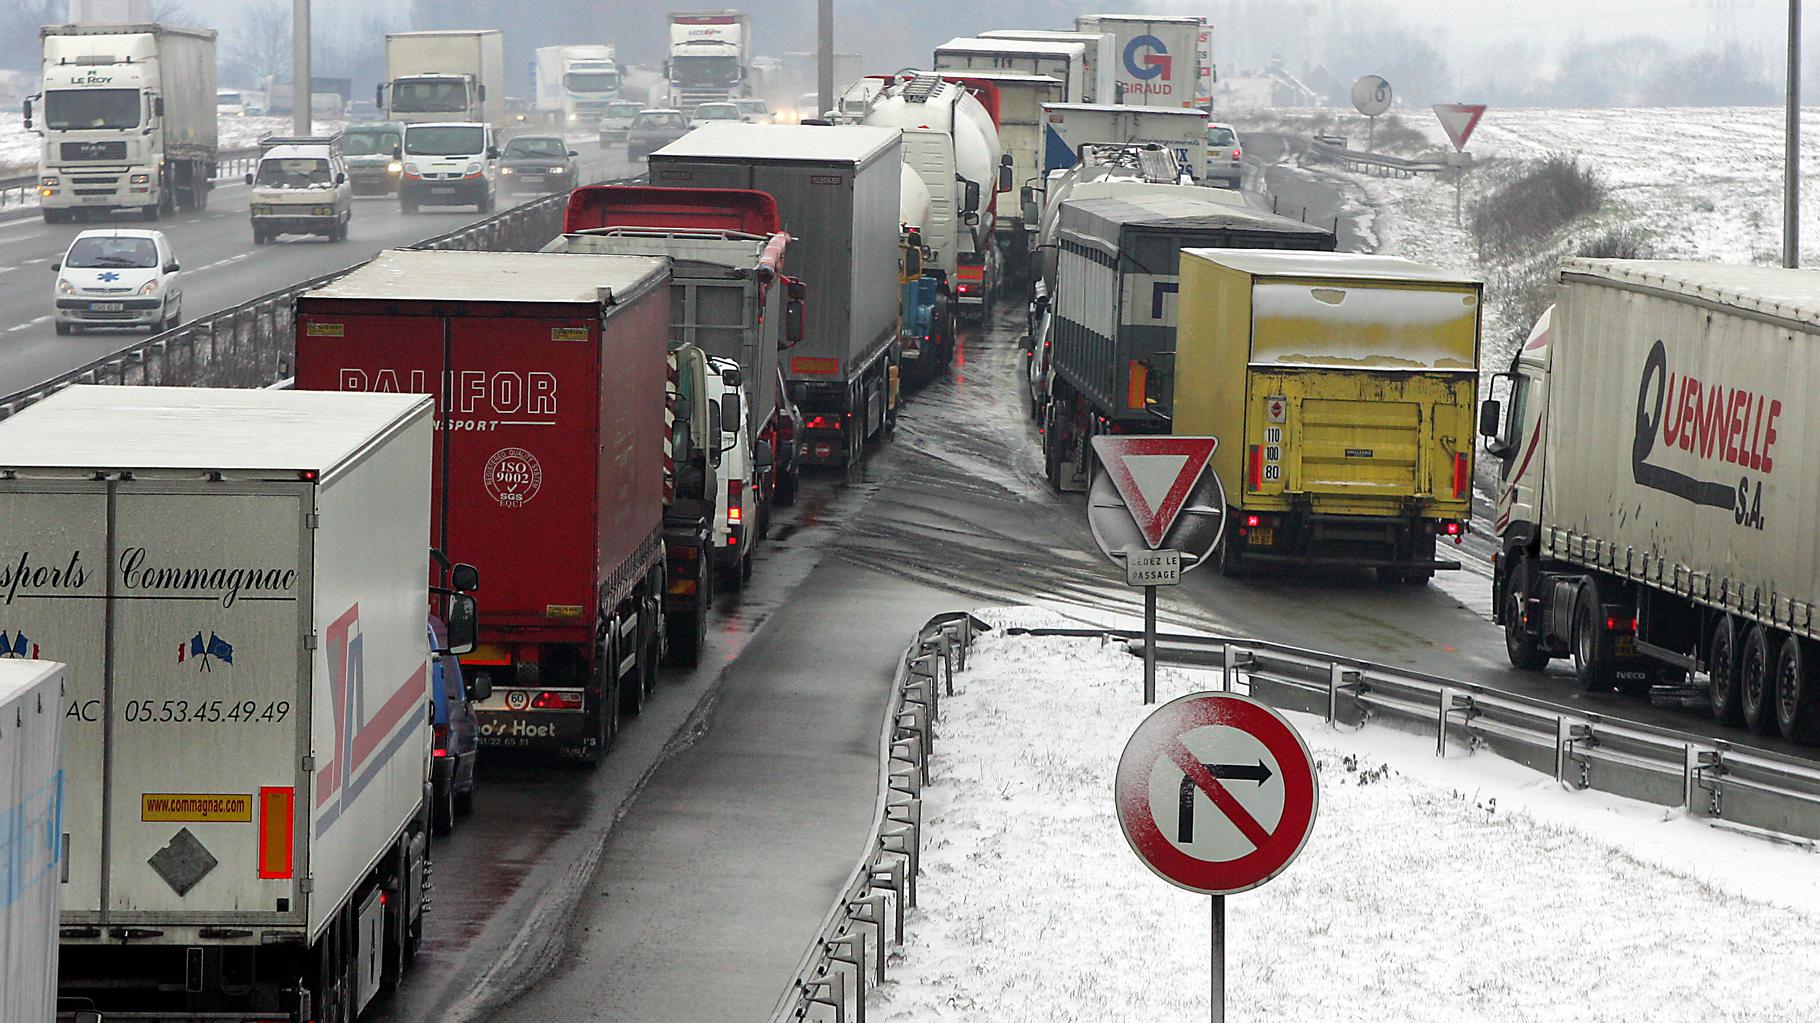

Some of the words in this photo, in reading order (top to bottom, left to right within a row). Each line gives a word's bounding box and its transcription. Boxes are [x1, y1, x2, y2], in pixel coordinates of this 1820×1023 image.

[1122, 82, 1172, 95] GIRAUD
[1632, 340, 1782, 474] QUENNELLE
[1267, 428, 1280, 443] 110
[1266, 446, 1279, 461] 100
[501, 462, 527, 473] ISO
[1265, 465, 1280, 479] 80
[496, 471, 529, 484] 9002
[1734, 476, 1765, 530] S.A.
[1132, 557, 1161, 566] EDEZ
[1166, 557, 1177, 565] LE
[119, 547, 298, 609] Commagnac
[1133, 570, 1176, 579] PASSAGE
[1616, 671, 1646, 680] IVECO
[511, 693, 524, 702] 60
[125, 700, 290, 723] 05.53.45.49.49
[478, 719, 507, 736] o's
[512, 719, 557, 737] Hoet
[146, 798, 245, 817] www.commagnac.com
